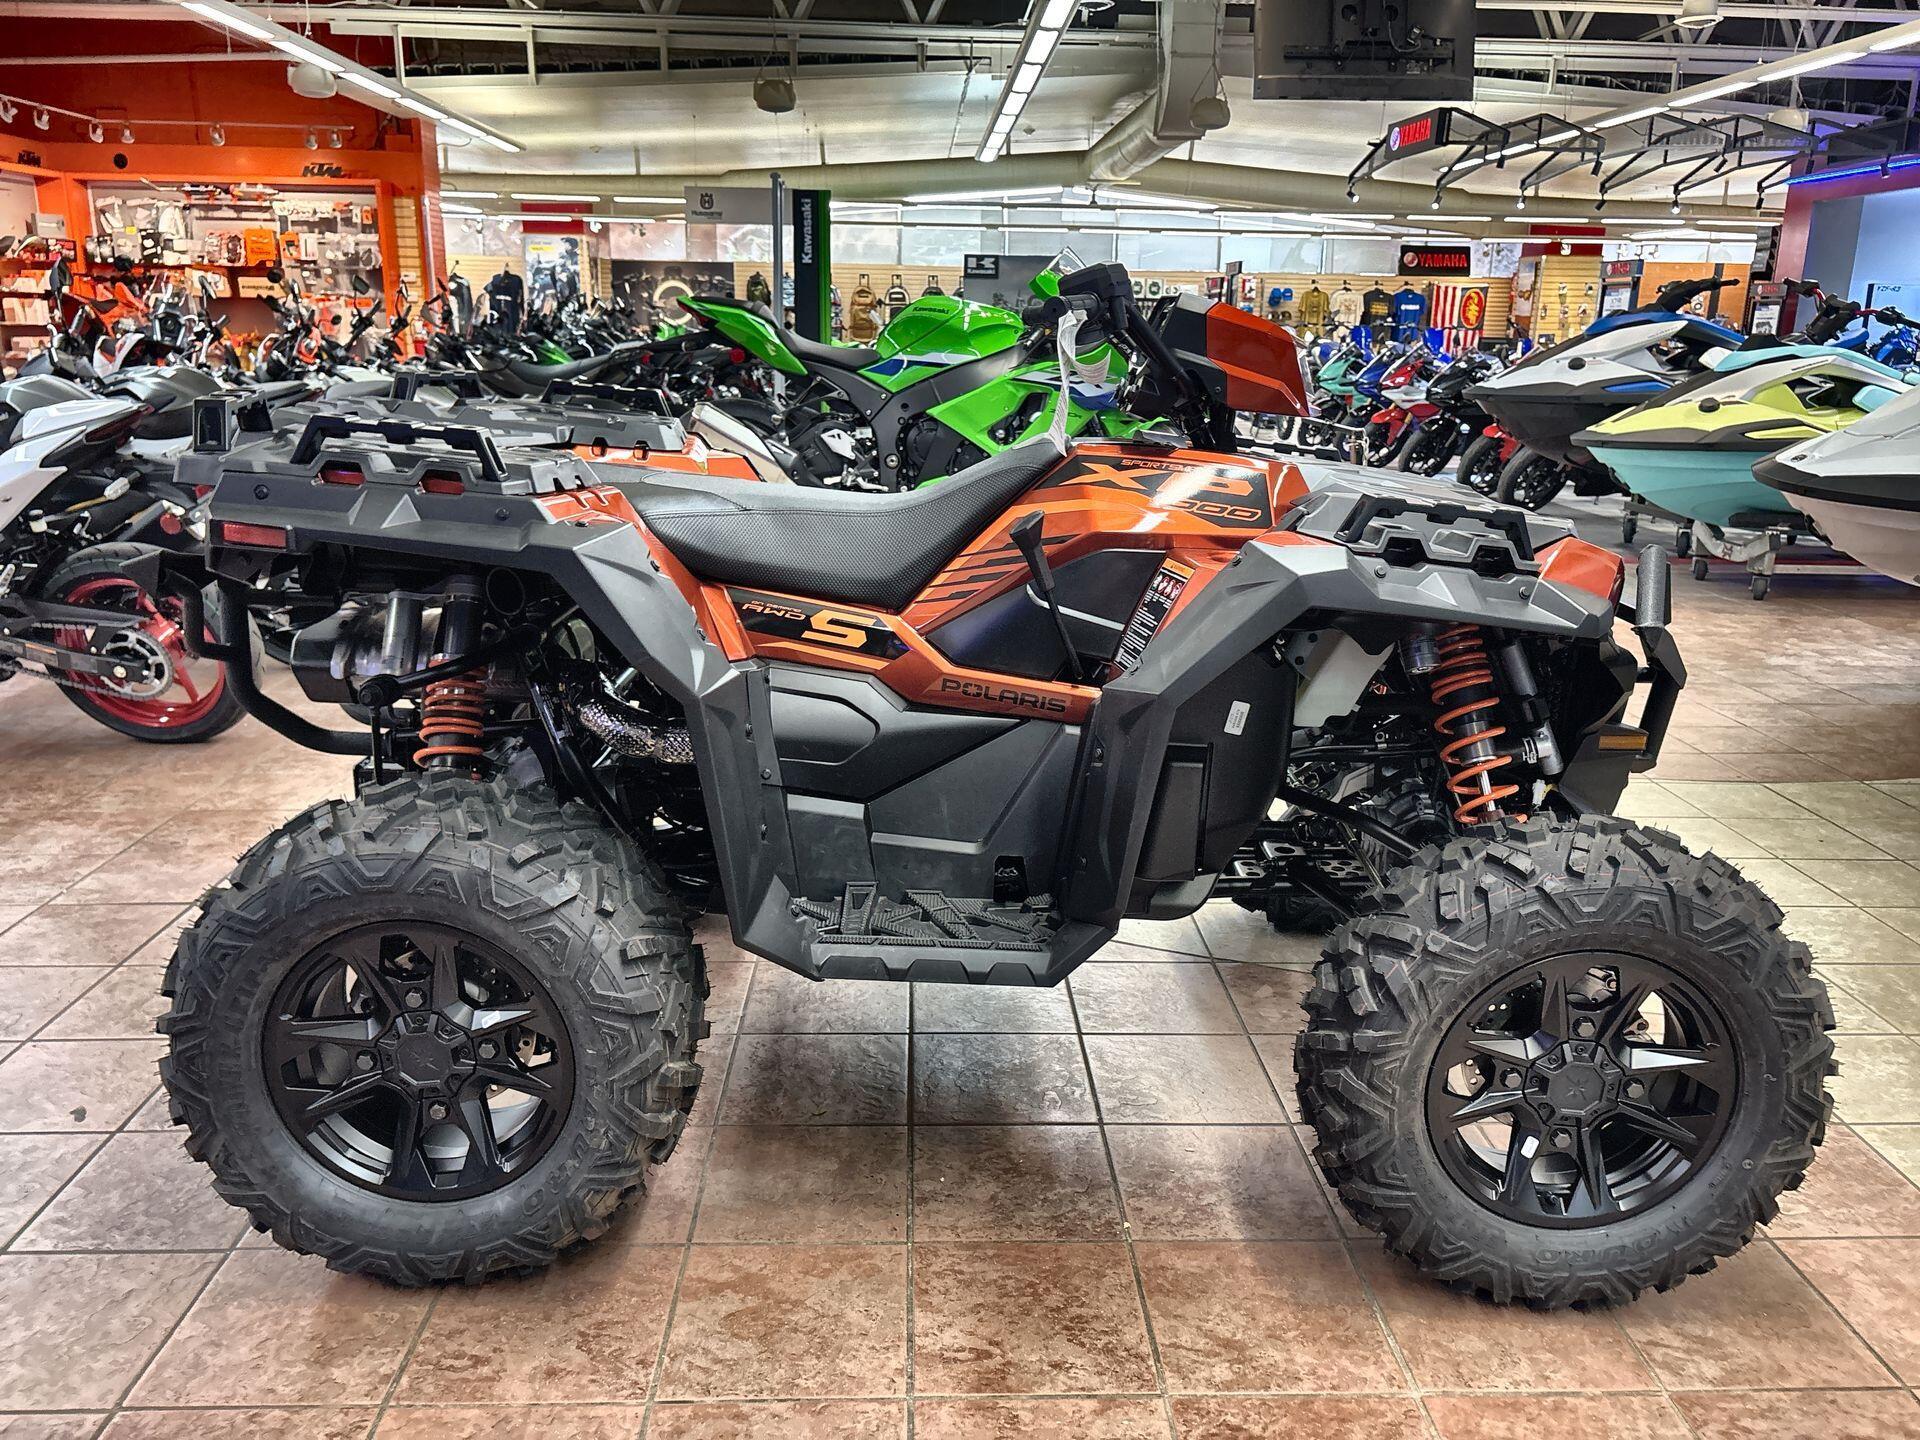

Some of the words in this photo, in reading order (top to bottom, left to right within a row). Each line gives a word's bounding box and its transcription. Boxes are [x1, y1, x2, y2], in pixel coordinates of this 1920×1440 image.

[1400, 118, 1431, 147] YAMAHA
[17, 150, 41, 167] KTM
[303, 162, 343, 177] KTM
[801, 198, 812, 263] Kawasaki
[1419, 253, 1467, 267] YAMAHA
[912, 306, 950, 315] Kawasaki
[742, 603, 806, 621] AWD
[801, 609, 867, 648] S
[941, 677, 1066, 713] POLARIS
